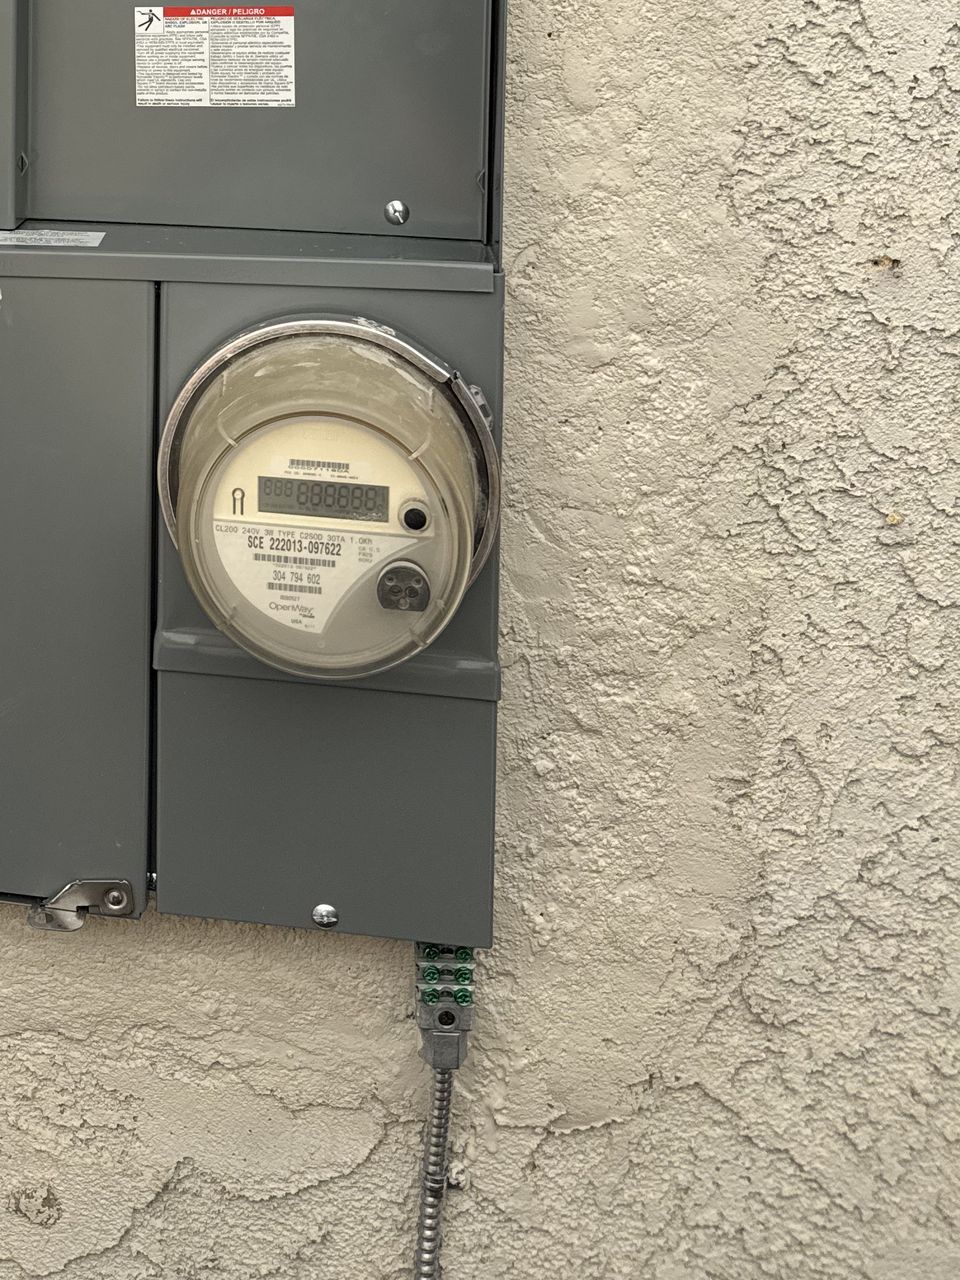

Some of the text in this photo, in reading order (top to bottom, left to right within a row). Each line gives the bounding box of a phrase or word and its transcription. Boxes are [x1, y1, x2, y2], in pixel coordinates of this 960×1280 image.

[196, 8, 227, 16] DANGER
[215, 525, 239, 534] CL200
[242, 527, 261, 536] 240V
[278, 530, 295, 539] TYPE
[247, 535, 264, 550] SCE
[269, 537, 342, 556] 222013-097622
[272, 570, 321, 585] 304 794 602
[268, 601, 314, 614] OpenWay
